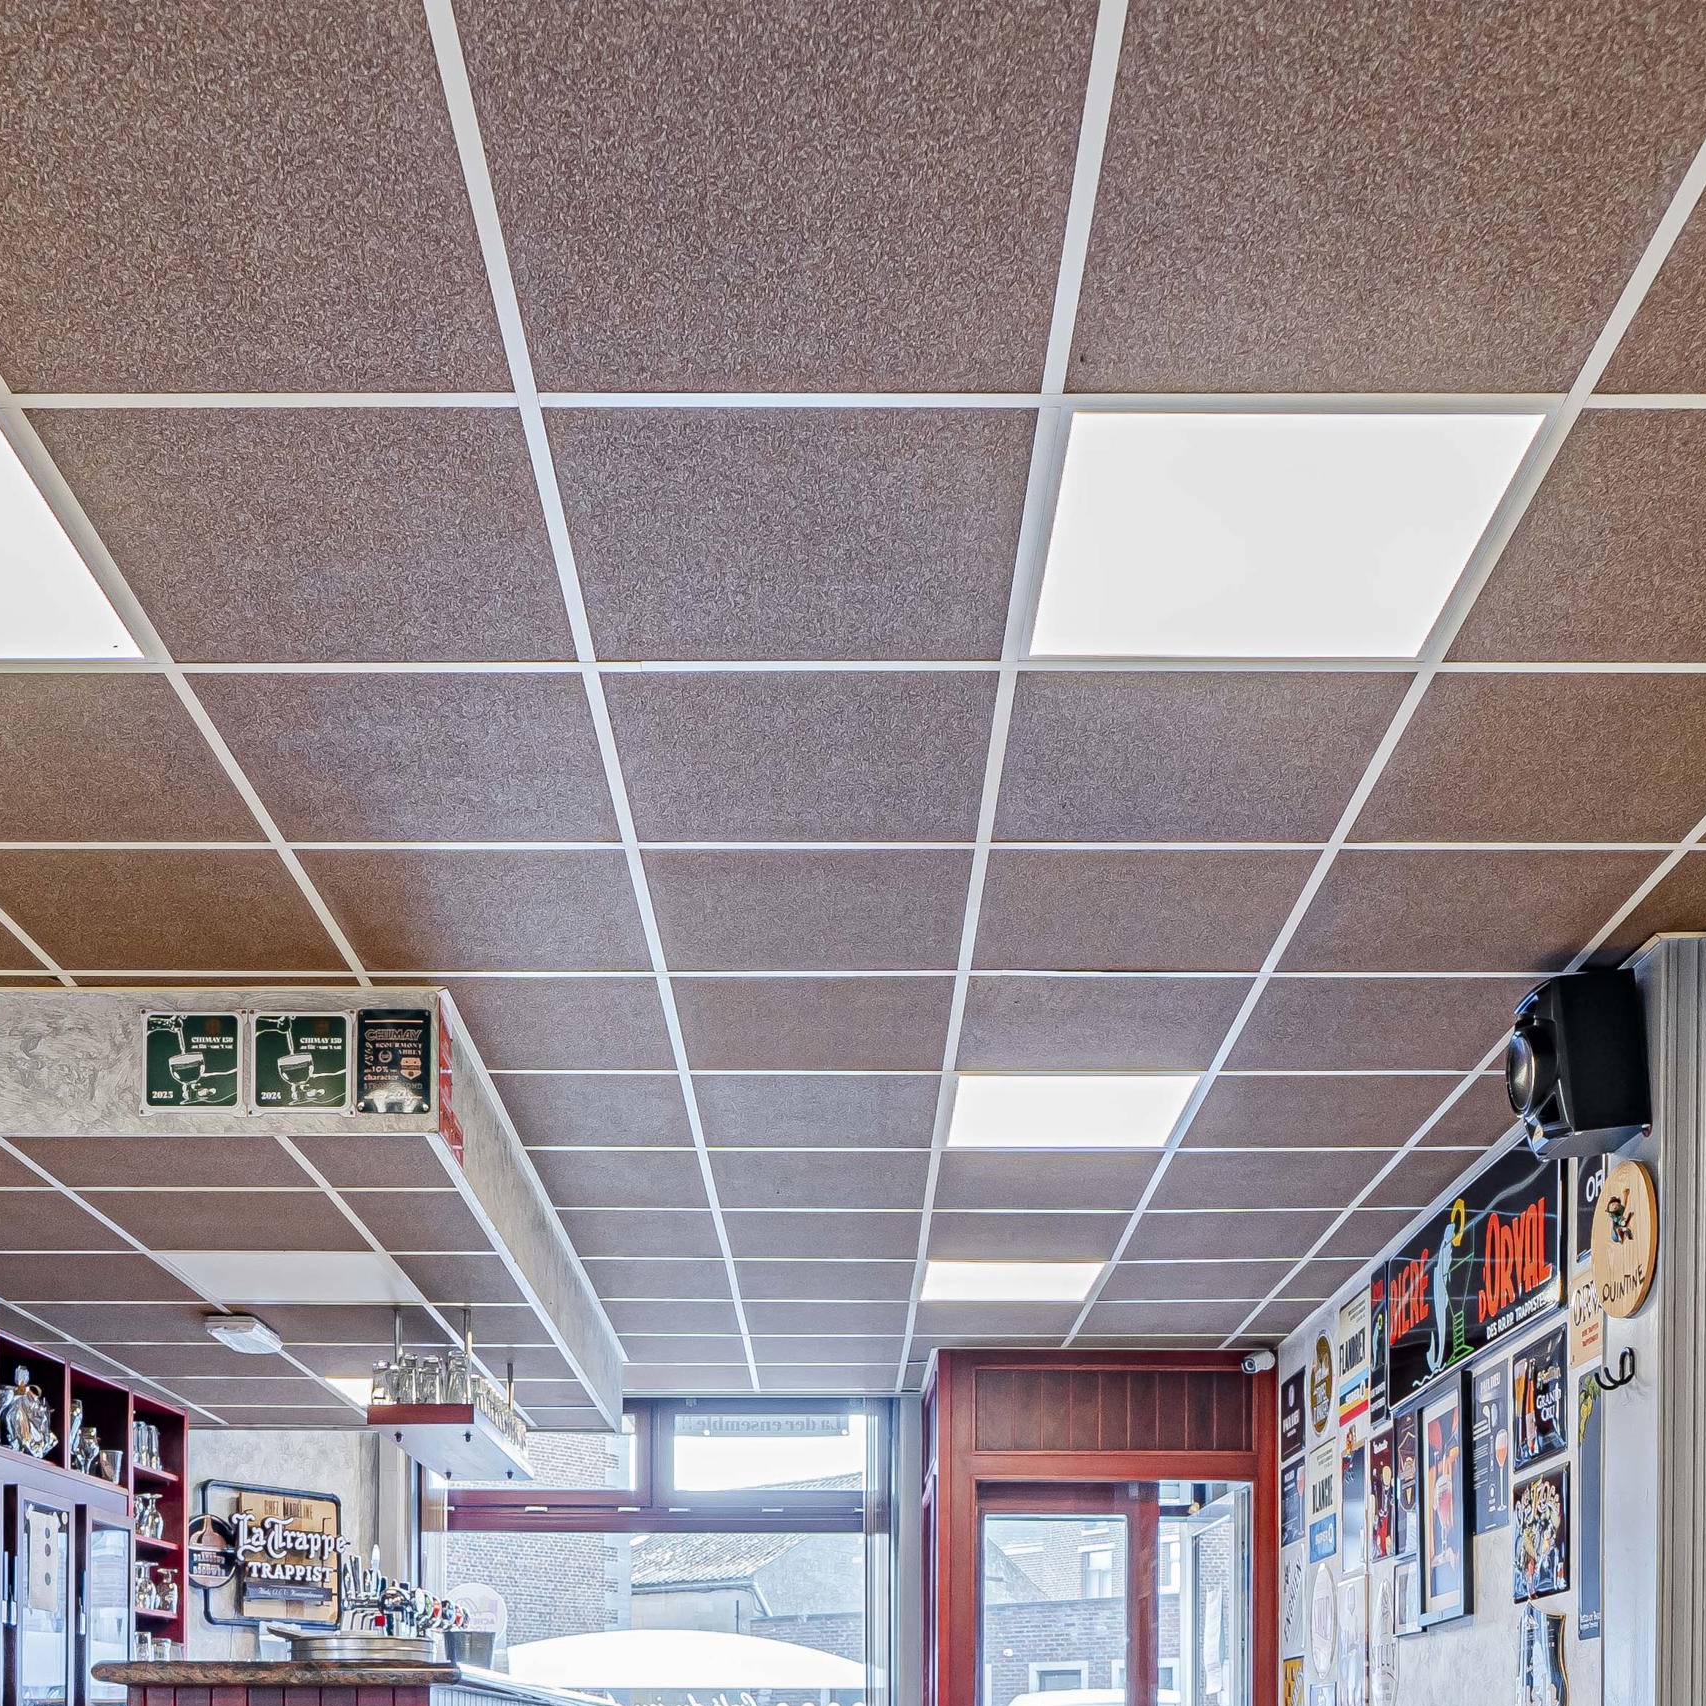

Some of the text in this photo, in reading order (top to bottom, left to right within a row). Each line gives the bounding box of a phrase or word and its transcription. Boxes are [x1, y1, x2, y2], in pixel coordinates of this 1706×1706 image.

[191, 1036, 221, 1044] CHIMAY
[364, 1028, 423, 1042] CHIMAY
[1602, 1263, 1646, 1304] QUINTINE
[231, 1512, 351, 1561] La Trappe
[246, 1561, 333, 1583] TRAPPIST
